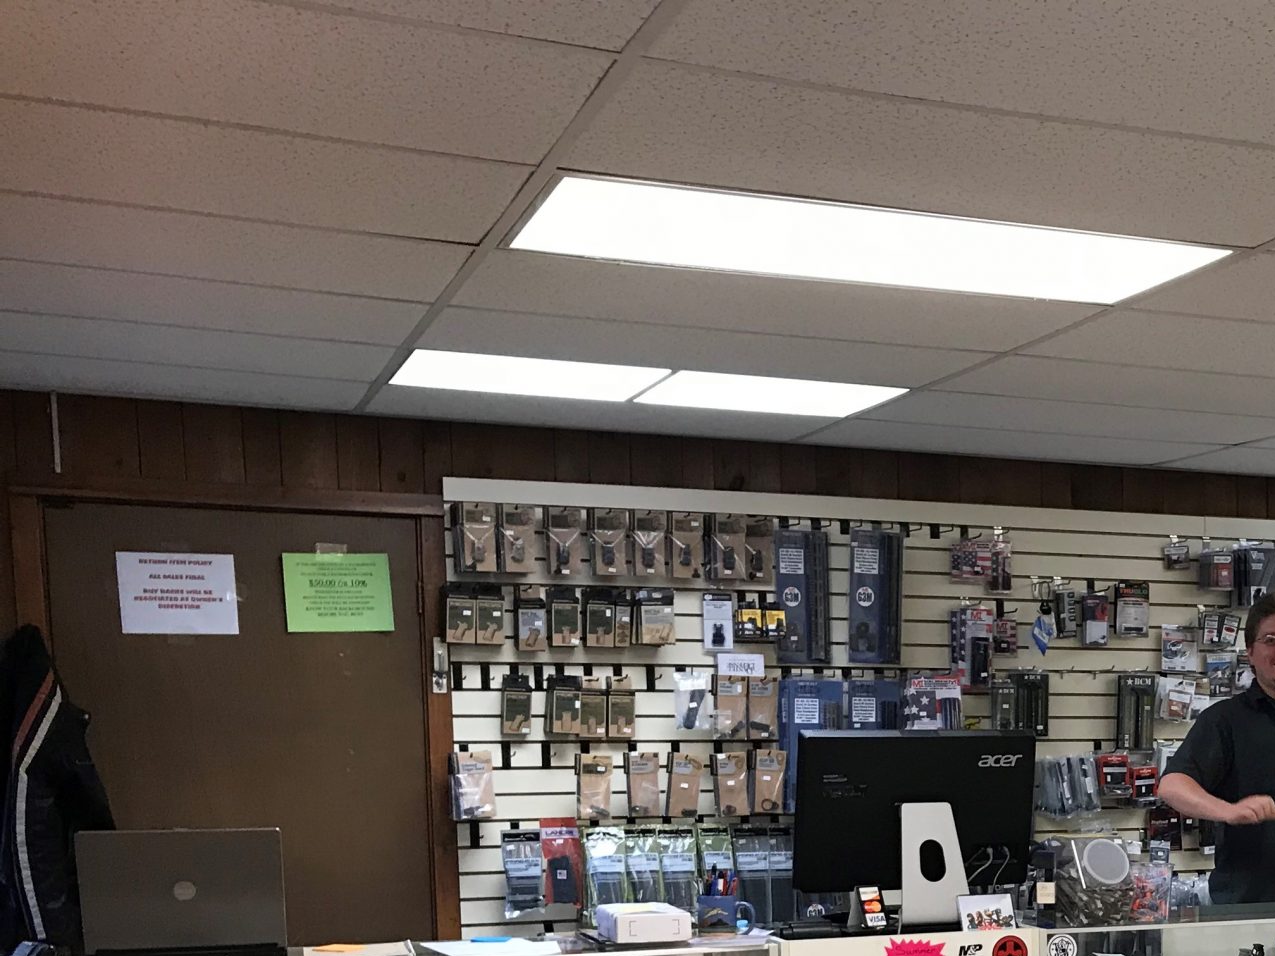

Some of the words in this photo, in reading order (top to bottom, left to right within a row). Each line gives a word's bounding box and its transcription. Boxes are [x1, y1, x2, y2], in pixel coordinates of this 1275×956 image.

[978, 754, 1023, 767] acer
[868, 915, 886, 923] VISA
[958, 944, 983, 956] M&P
